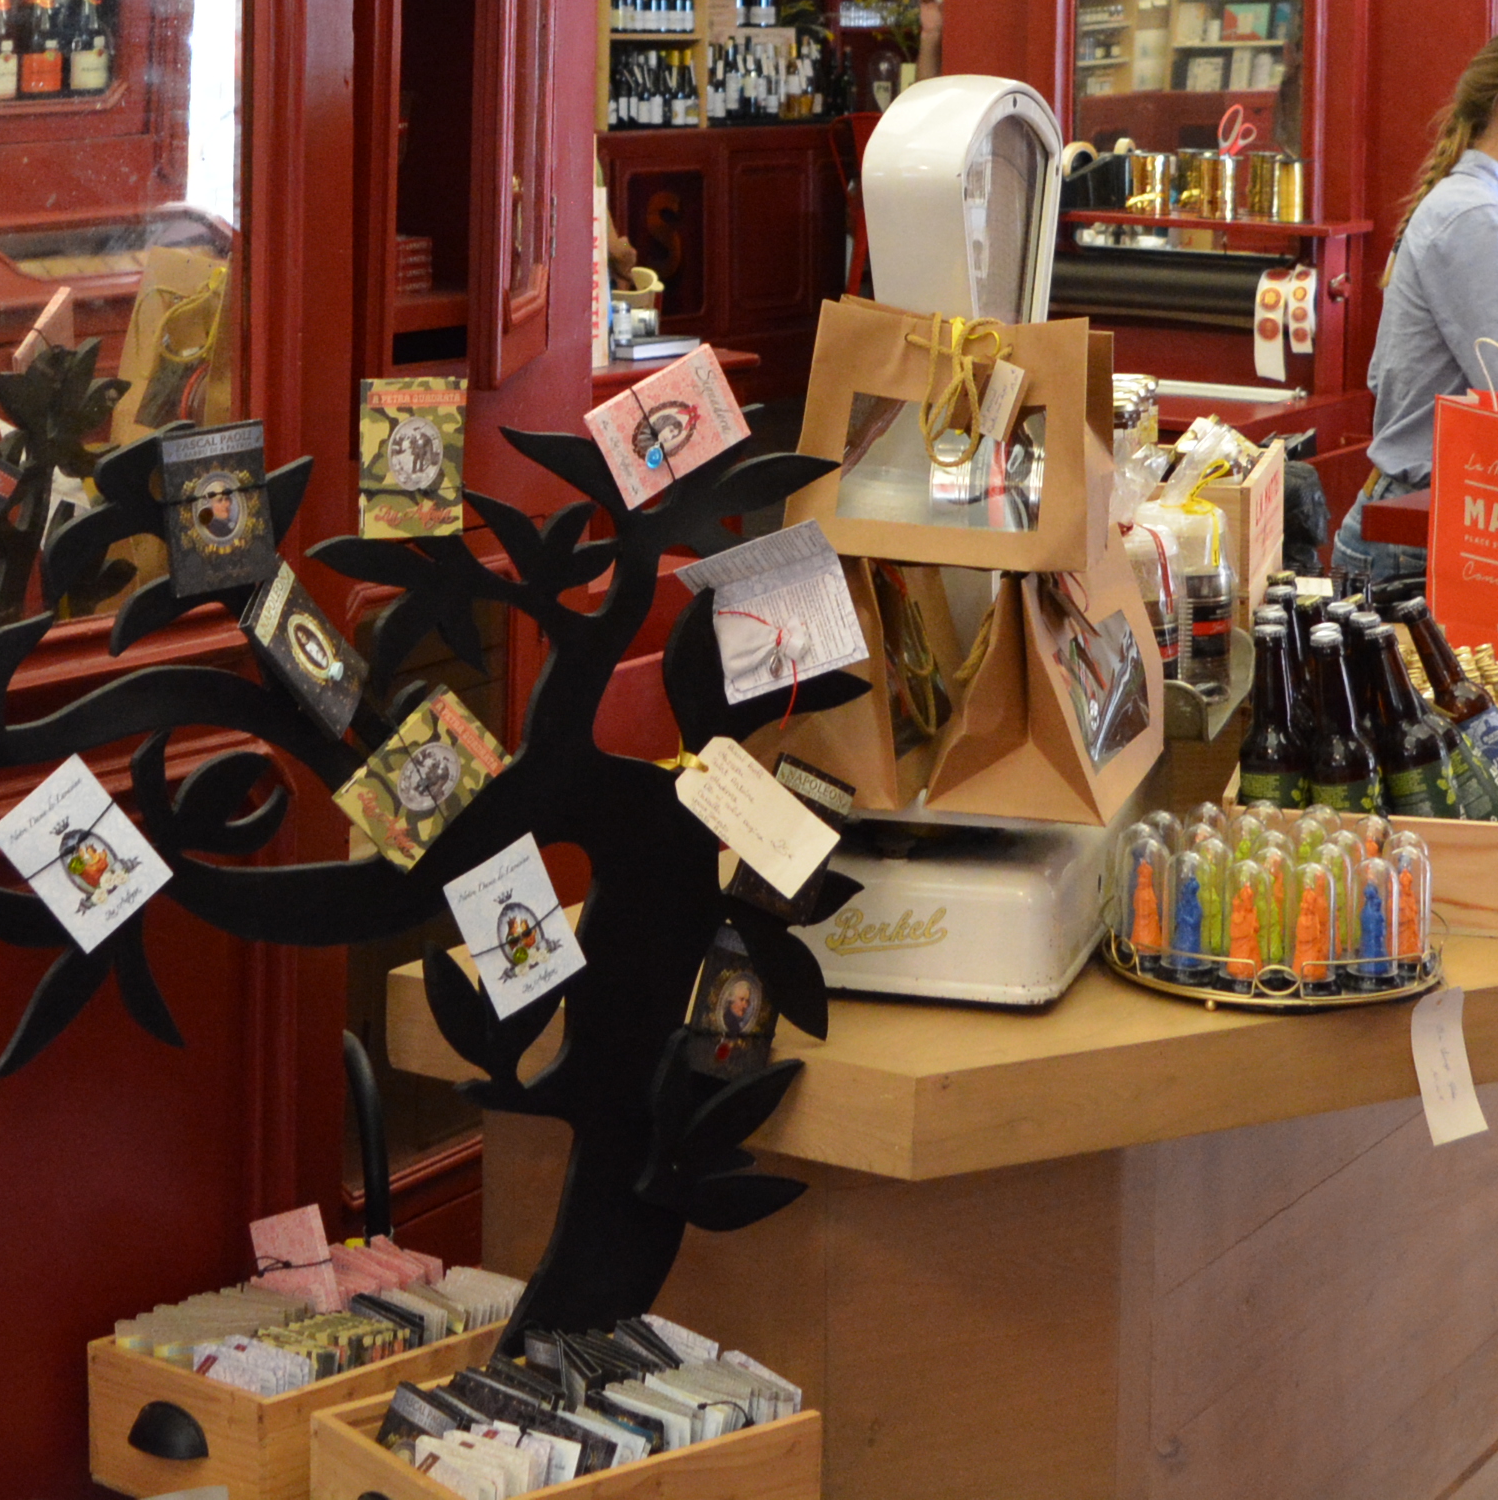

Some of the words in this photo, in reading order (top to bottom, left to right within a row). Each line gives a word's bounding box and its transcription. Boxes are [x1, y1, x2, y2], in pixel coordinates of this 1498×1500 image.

[1464, 453, 1484, 471] La
[1464, 534, 1490, 547] PLACE
[788, 768, 847, 806] NAPOLEON
[825, 907, 947, 952] Berkel
